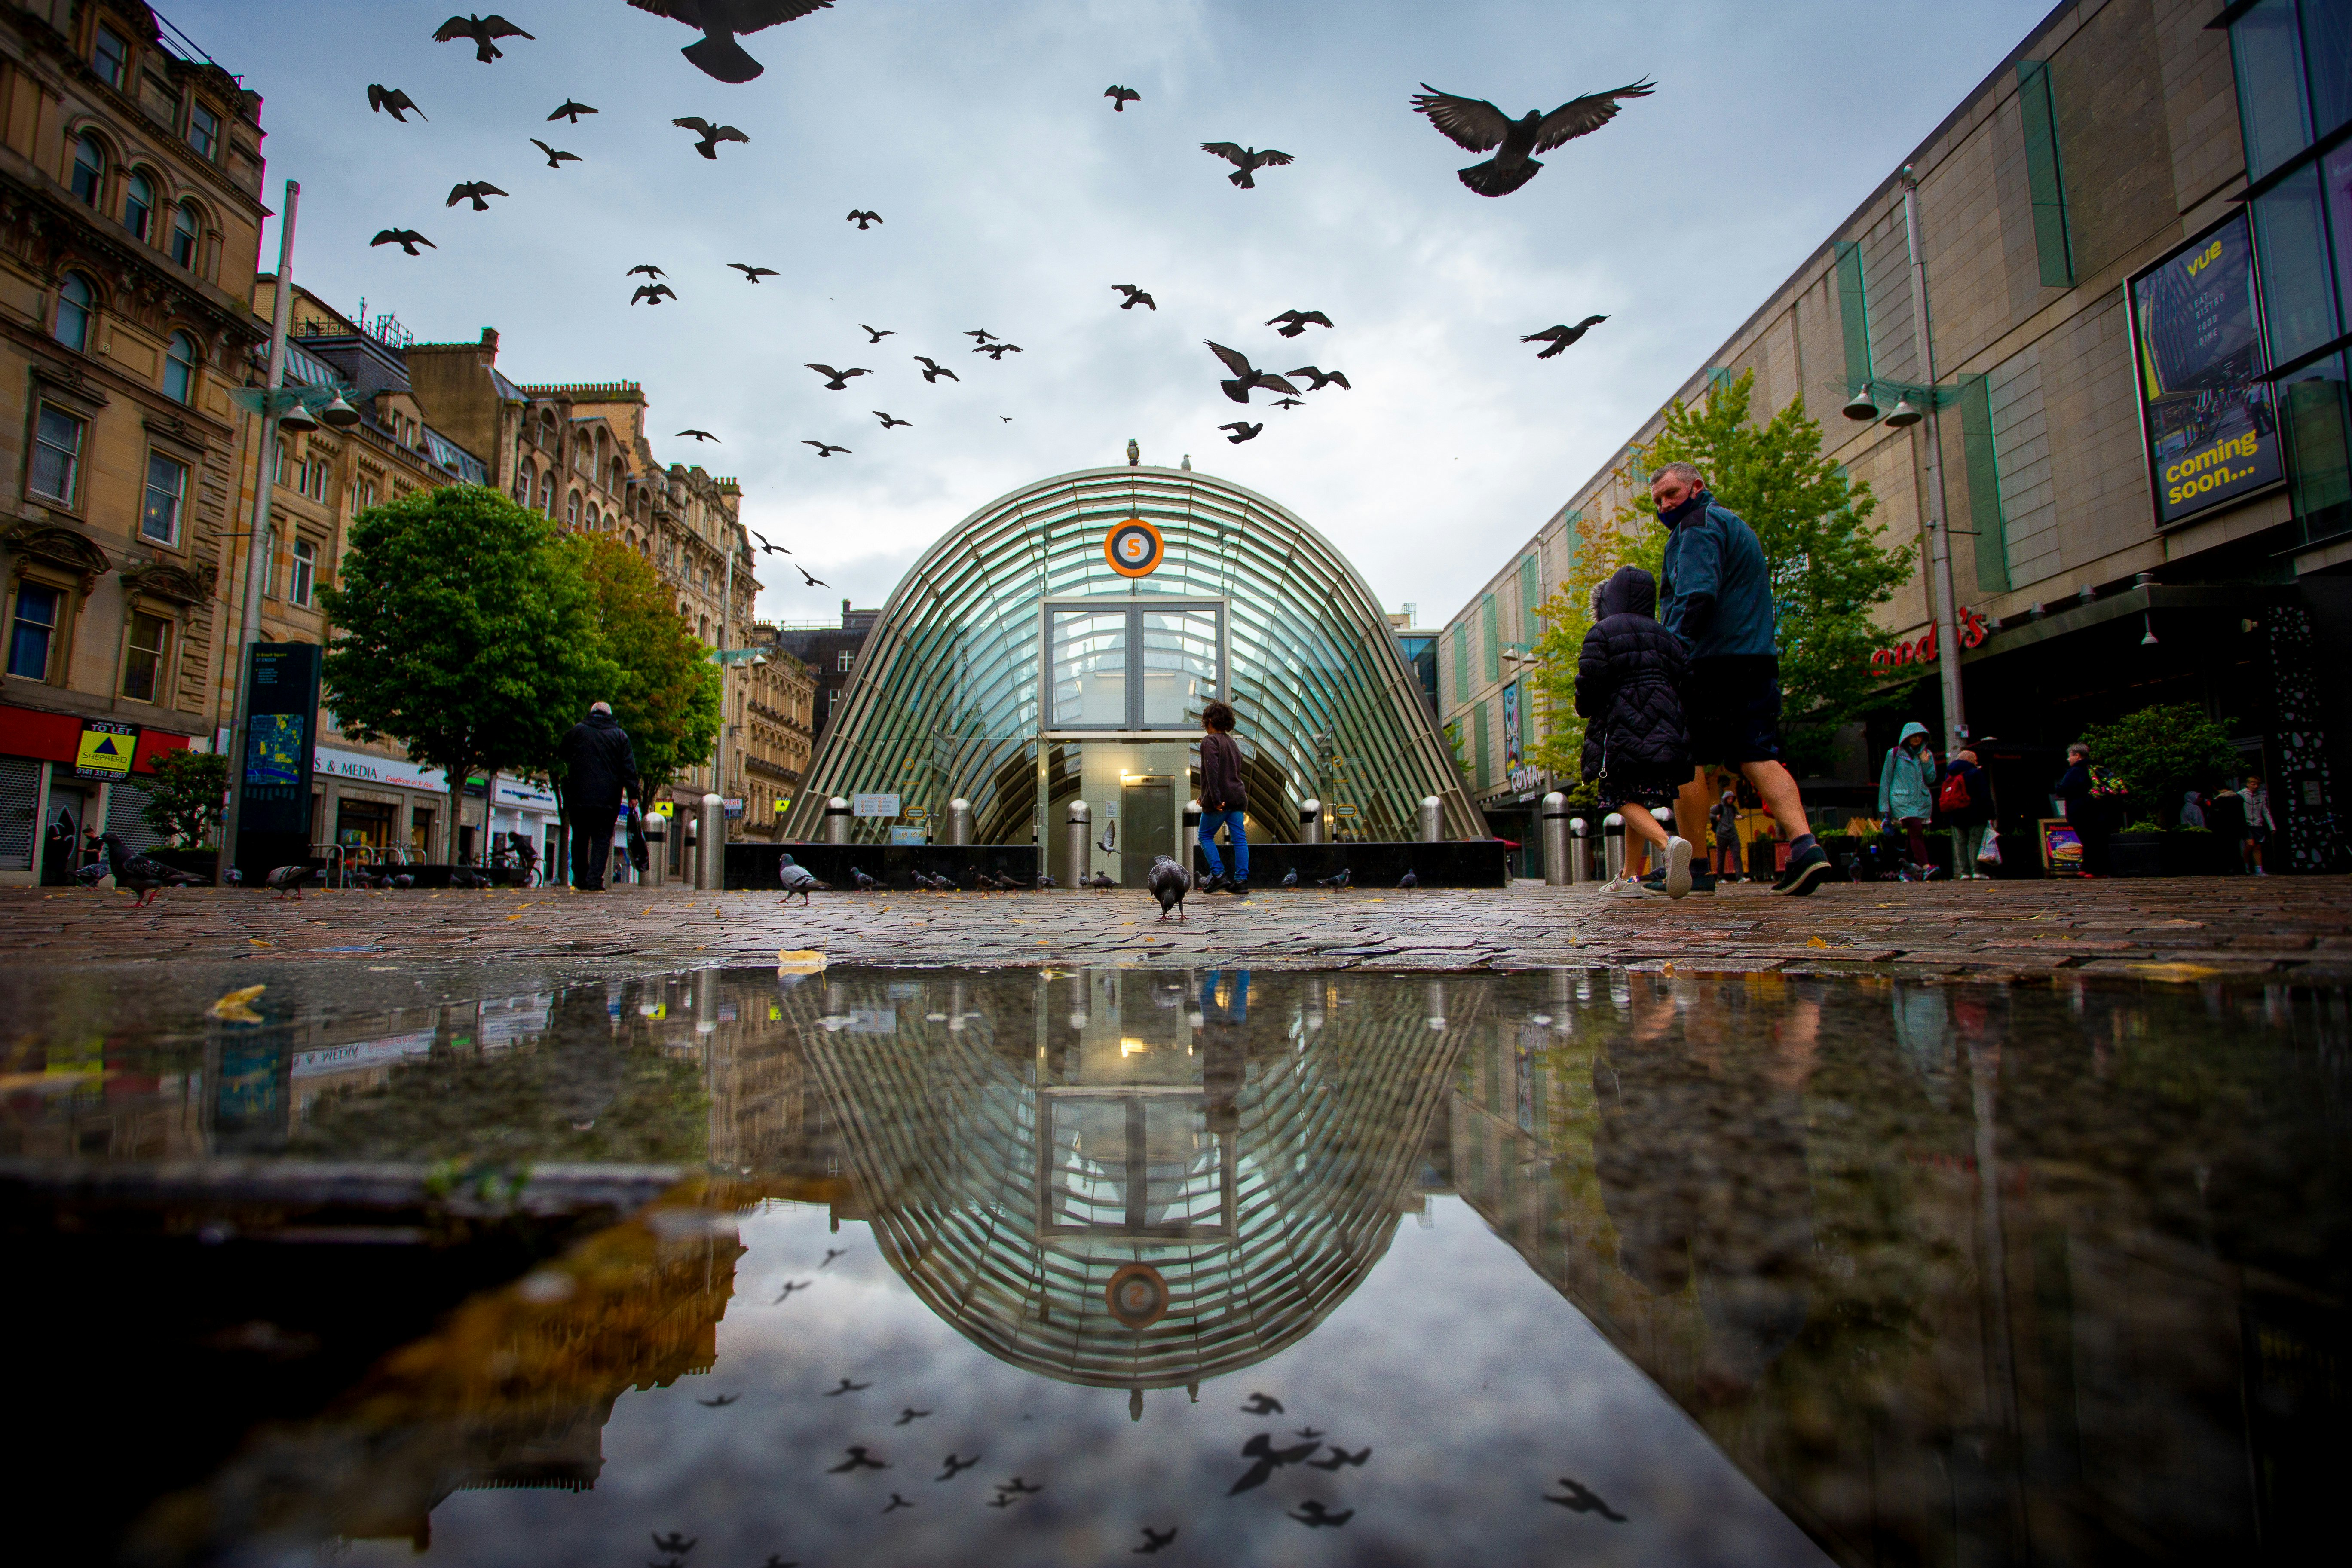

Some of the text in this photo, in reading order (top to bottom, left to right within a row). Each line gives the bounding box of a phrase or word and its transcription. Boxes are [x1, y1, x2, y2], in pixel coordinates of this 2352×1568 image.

[2187, 240, 2223, 277] vue
[2194, 291, 2209, 309] EAT
[2195, 292, 2225, 320] BISTRO
[2197, 314, 2218, 334] FOOD
[2198, 328, 2218, 346] DINE
[2166, 429, 2258, 483] coming
[2168, 466, 2255, 505] soon...
[1127, 538, 1141, 557] S
[1862, 606, 1984, 677] and's
[91, 724, 132, 735] TO LET
[82, 752, 128, 763] SHEPHERD
[314, 757, 377, 780] S & MEDIA
[1512, 765, 1541, 792] COSTA
